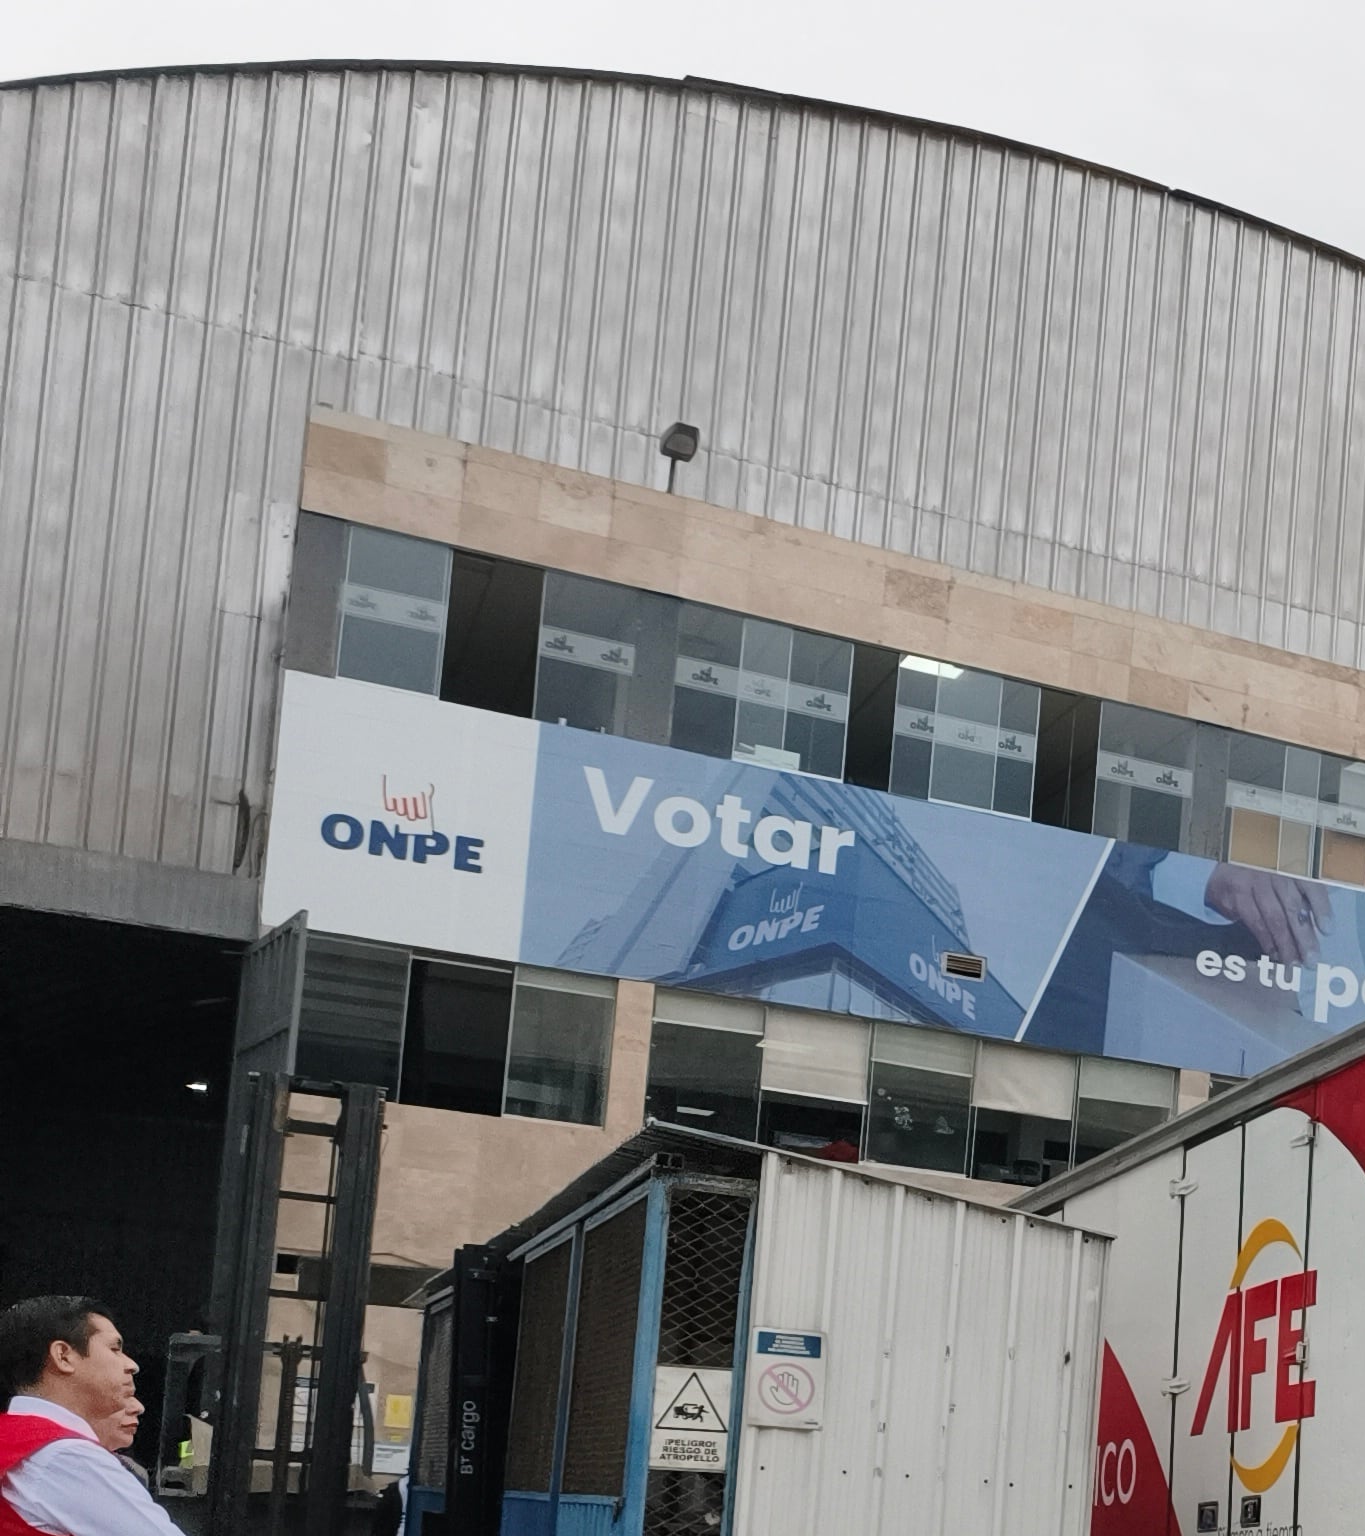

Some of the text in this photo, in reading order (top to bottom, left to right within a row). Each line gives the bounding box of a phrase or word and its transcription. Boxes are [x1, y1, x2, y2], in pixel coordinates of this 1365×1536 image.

[320, 813, 485, 874] ONPE
[583, 765, 856, 876] Votar
[728, 905, 825, 952] ONPE
[909, 952, 977, 1021] ONPE
[1196, 949, 1246, 983] es
[1258, 954, 1301, 992] tu
[1190, 1270, 1318, 1436] AFE
[461, 1400, 479, 1449] cargo
[659, 1454, 720, 1463] ATROPELLO
[662, 1446, 718, 1455] RIESGO DE
